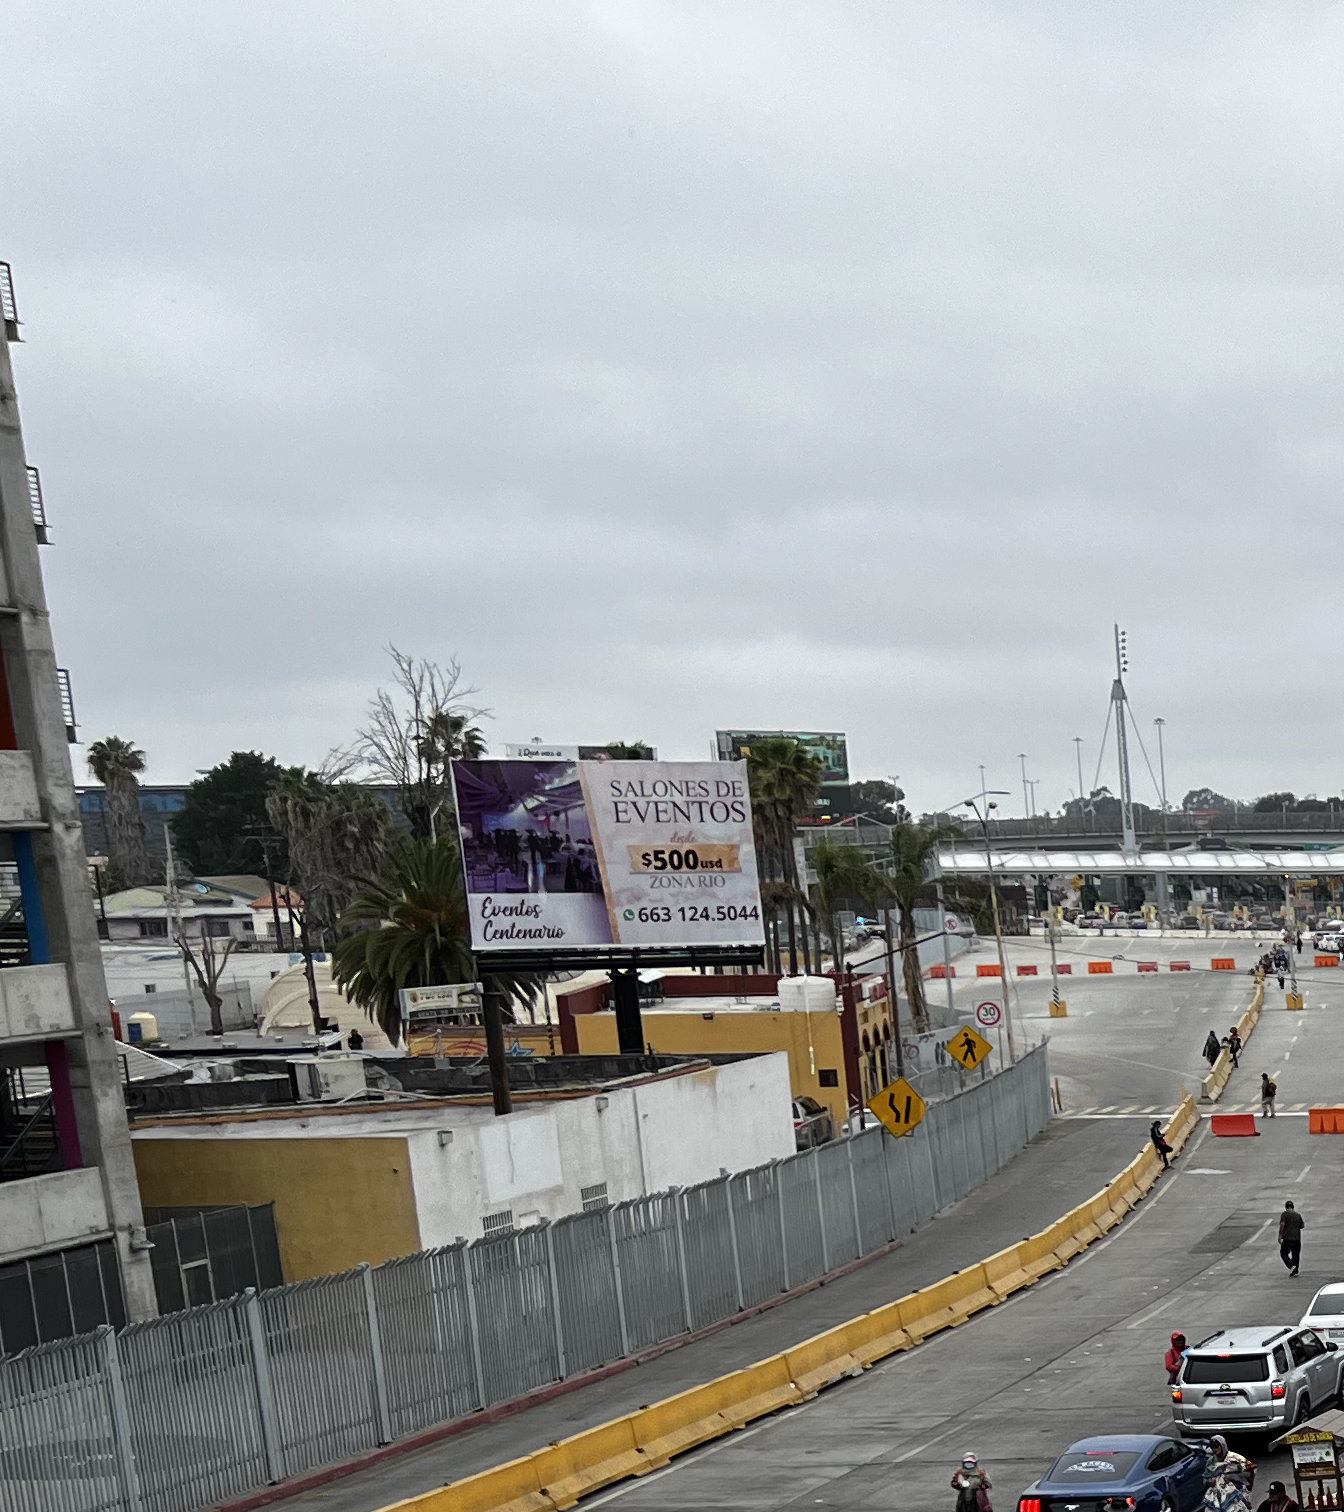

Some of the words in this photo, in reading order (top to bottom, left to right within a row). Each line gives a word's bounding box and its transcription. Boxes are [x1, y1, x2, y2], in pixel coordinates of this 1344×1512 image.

[610, 780, 709, 798] SALONES
[716, 780, 744, 798] DE
[614, 801, 746, 824] EVENTOS
[650, 875, 695, 889] ZONA
[698, 874, 726, 888] RIO
[481, 896, 542, 920] Eventos
[638, 905, 672, 922] 663
[678, 905, 760, 922] 124.5044
[483, 920, 565, 942] Centenario
[983, 1007, 996, 1016] 30
